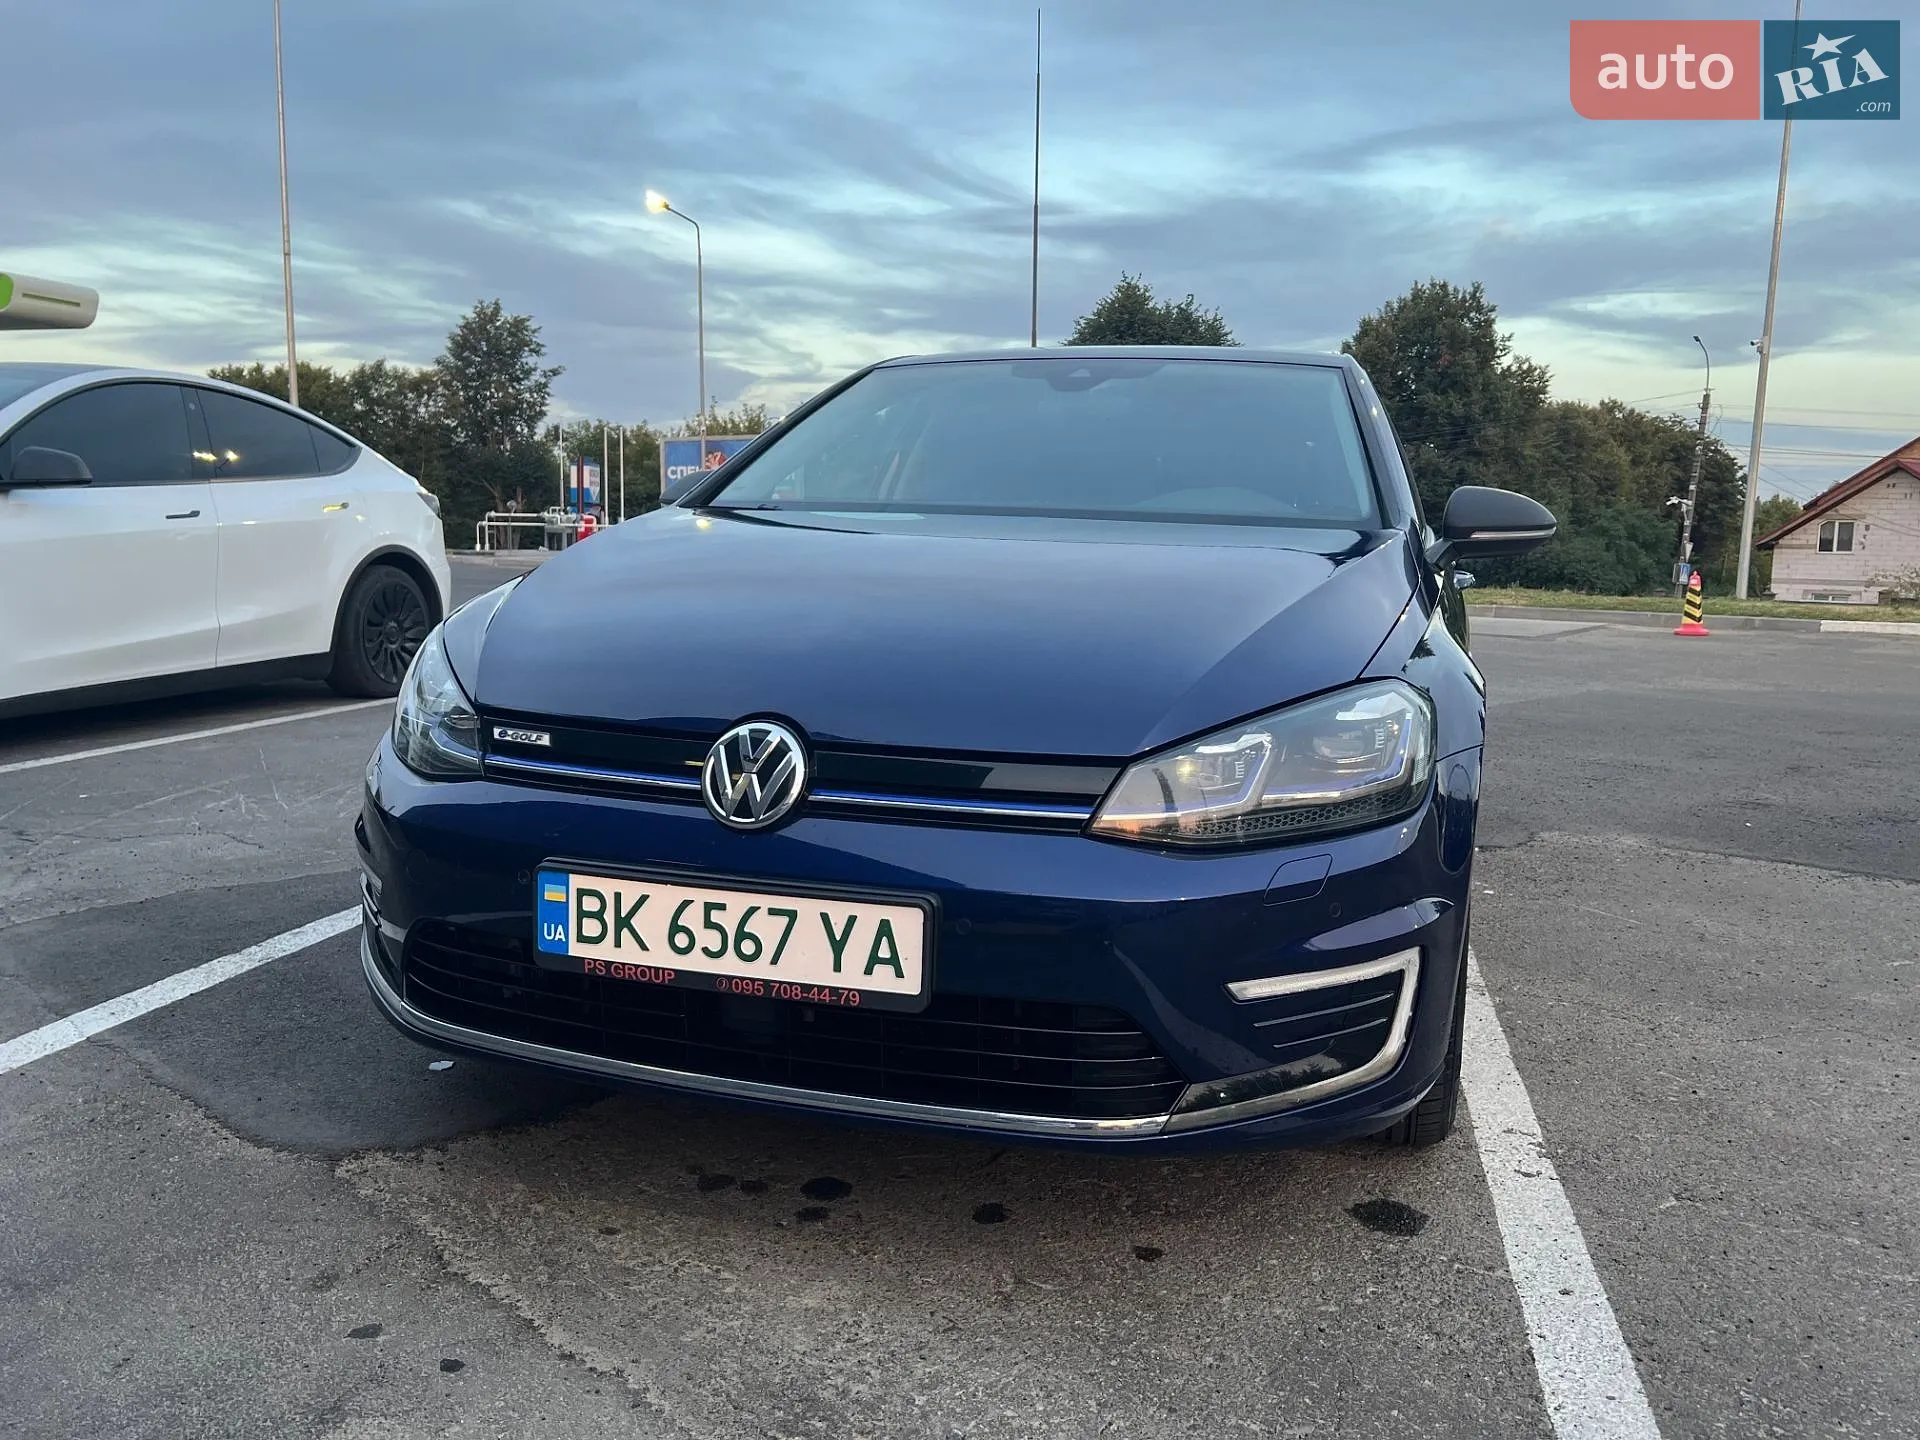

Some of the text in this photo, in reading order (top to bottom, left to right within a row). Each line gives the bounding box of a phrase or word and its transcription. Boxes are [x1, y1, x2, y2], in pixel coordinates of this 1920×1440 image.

[543, 887, 905, 979] UA BK 6567 YA
[584, 958, 675, 985] PS GROUP
[731, 978, 861, 1007] 095 708-44-79
